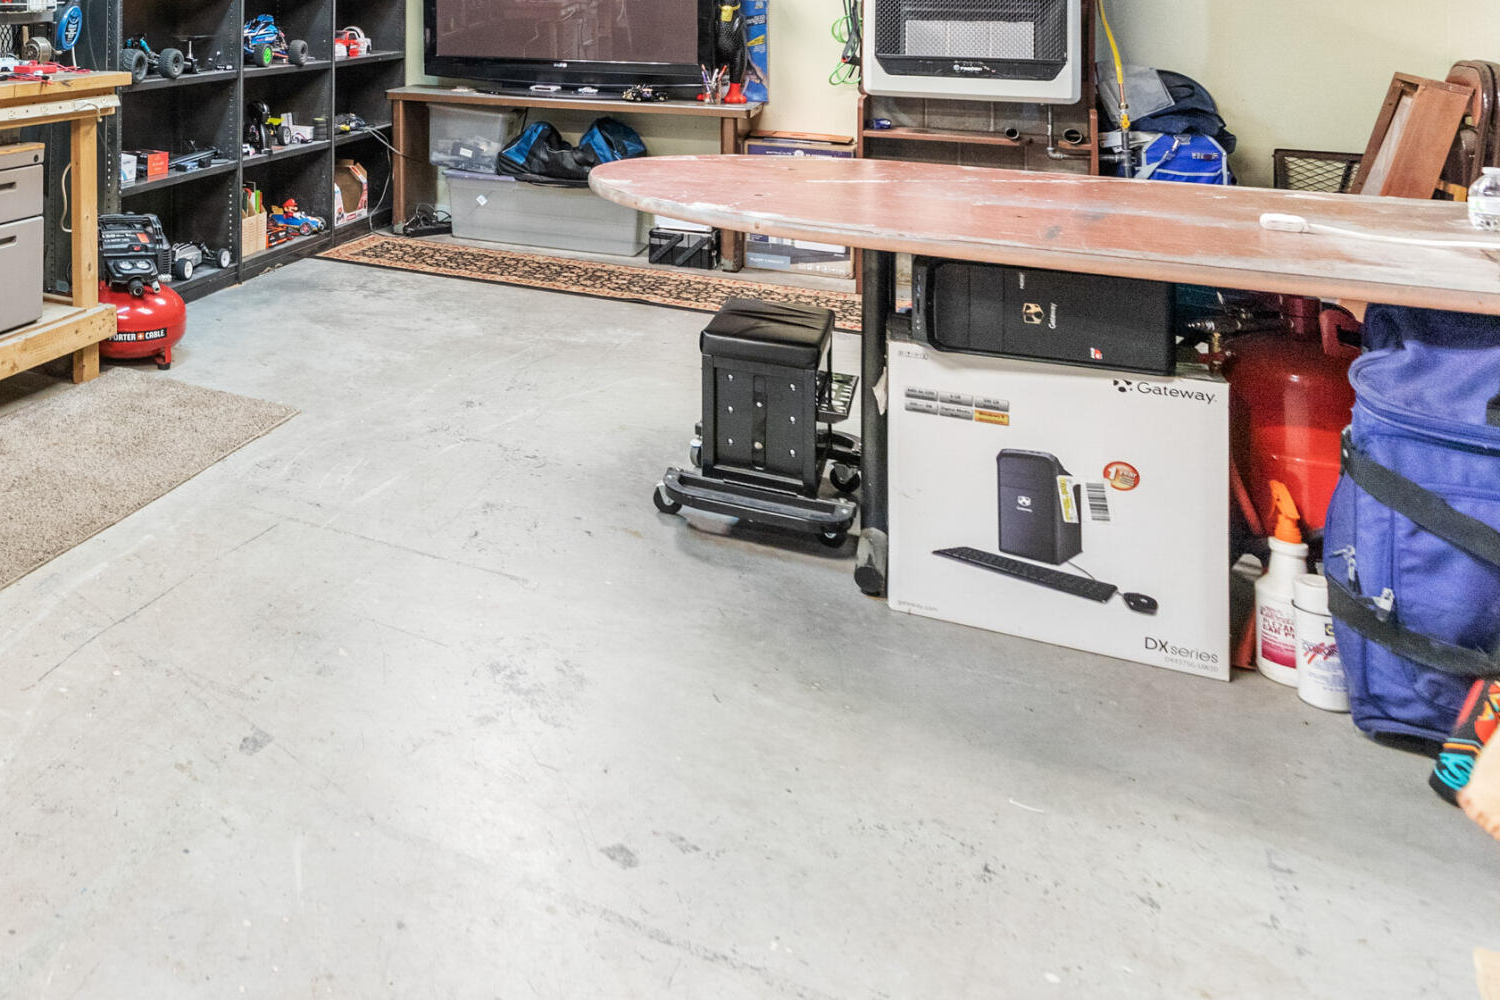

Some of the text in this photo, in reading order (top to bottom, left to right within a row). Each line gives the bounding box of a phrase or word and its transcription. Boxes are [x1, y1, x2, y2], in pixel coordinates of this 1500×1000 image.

[1048, 302, 1058, 329] Gateway
[145, 329, 165, 341] CABLE
[1137, 381, 1216, 404] Gateway
